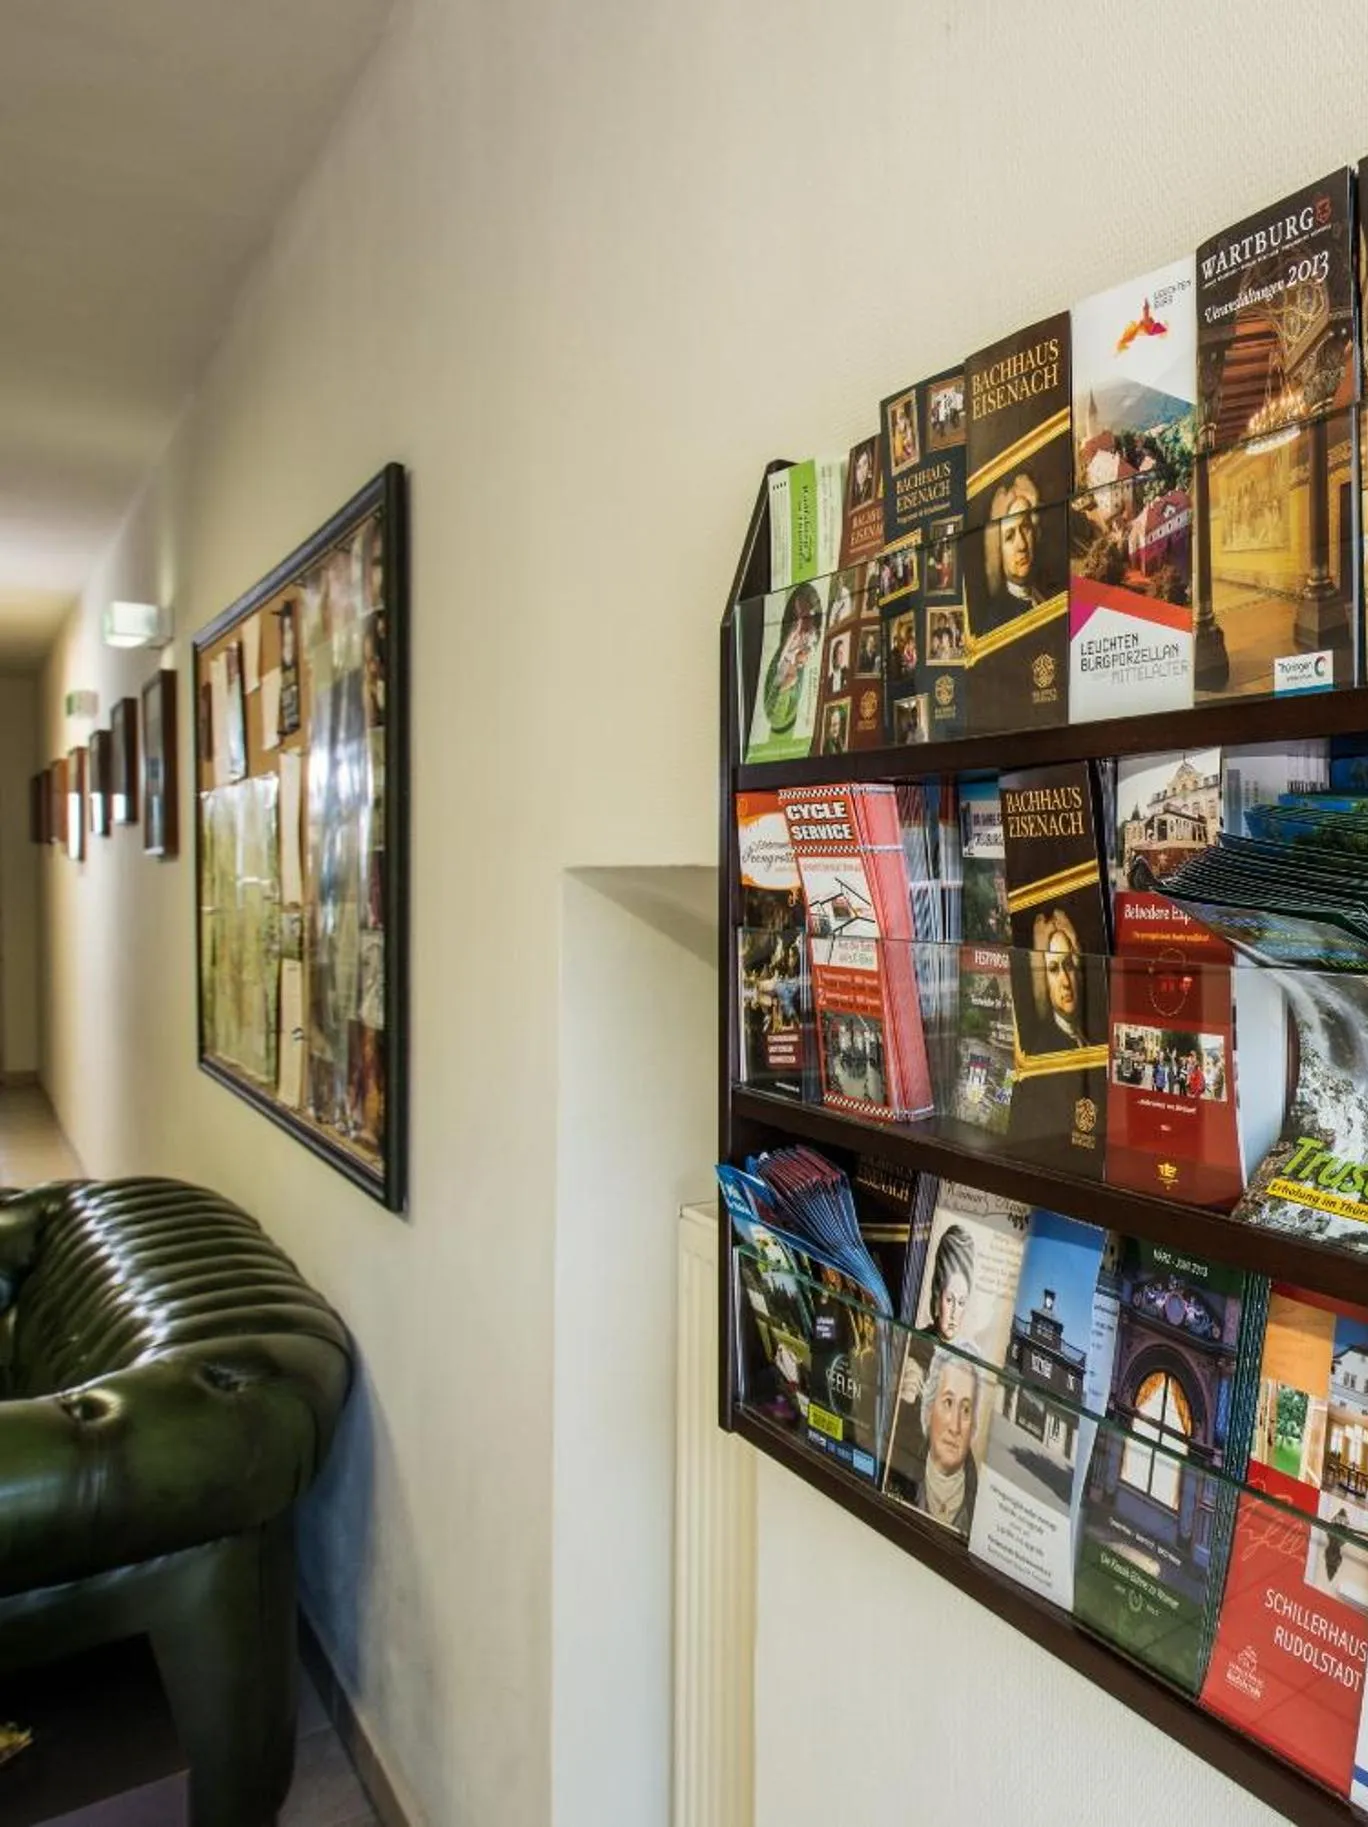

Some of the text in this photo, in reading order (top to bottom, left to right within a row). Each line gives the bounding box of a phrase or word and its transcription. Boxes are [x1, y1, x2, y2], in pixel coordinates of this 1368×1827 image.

[1200, 207, 1315, 280] WARTBURG
[1286, 251, 1330, 290] 2013
[972, 338, 1059, 396] BACHHAUS
[972, 362, 1058, 420] EISENACH
[896, 461, 951, 495] BACHHAUS
[896, 480, 951, 513] EISENACH
[1080, 632, 1139, 656] LEUCHTEN
[1080, 643, 1180, 673] BURGPORZELLAN
[785, 801, 849, 820] CYCLE
[1005, 787, 1083, 814] BACHHAUS
[791, 823, 853, 840] SERVICE
[1007, 811, 1085, 838] EISENACH
[1171, 906, 1193, 925] Exp
[1270, 1183, 1321, 1205] Erholung
[1264, 1588, 1368, 1663] SCHILLERHAUS
[1274, 1625, 1362, 1692] RUDOLSTADT
